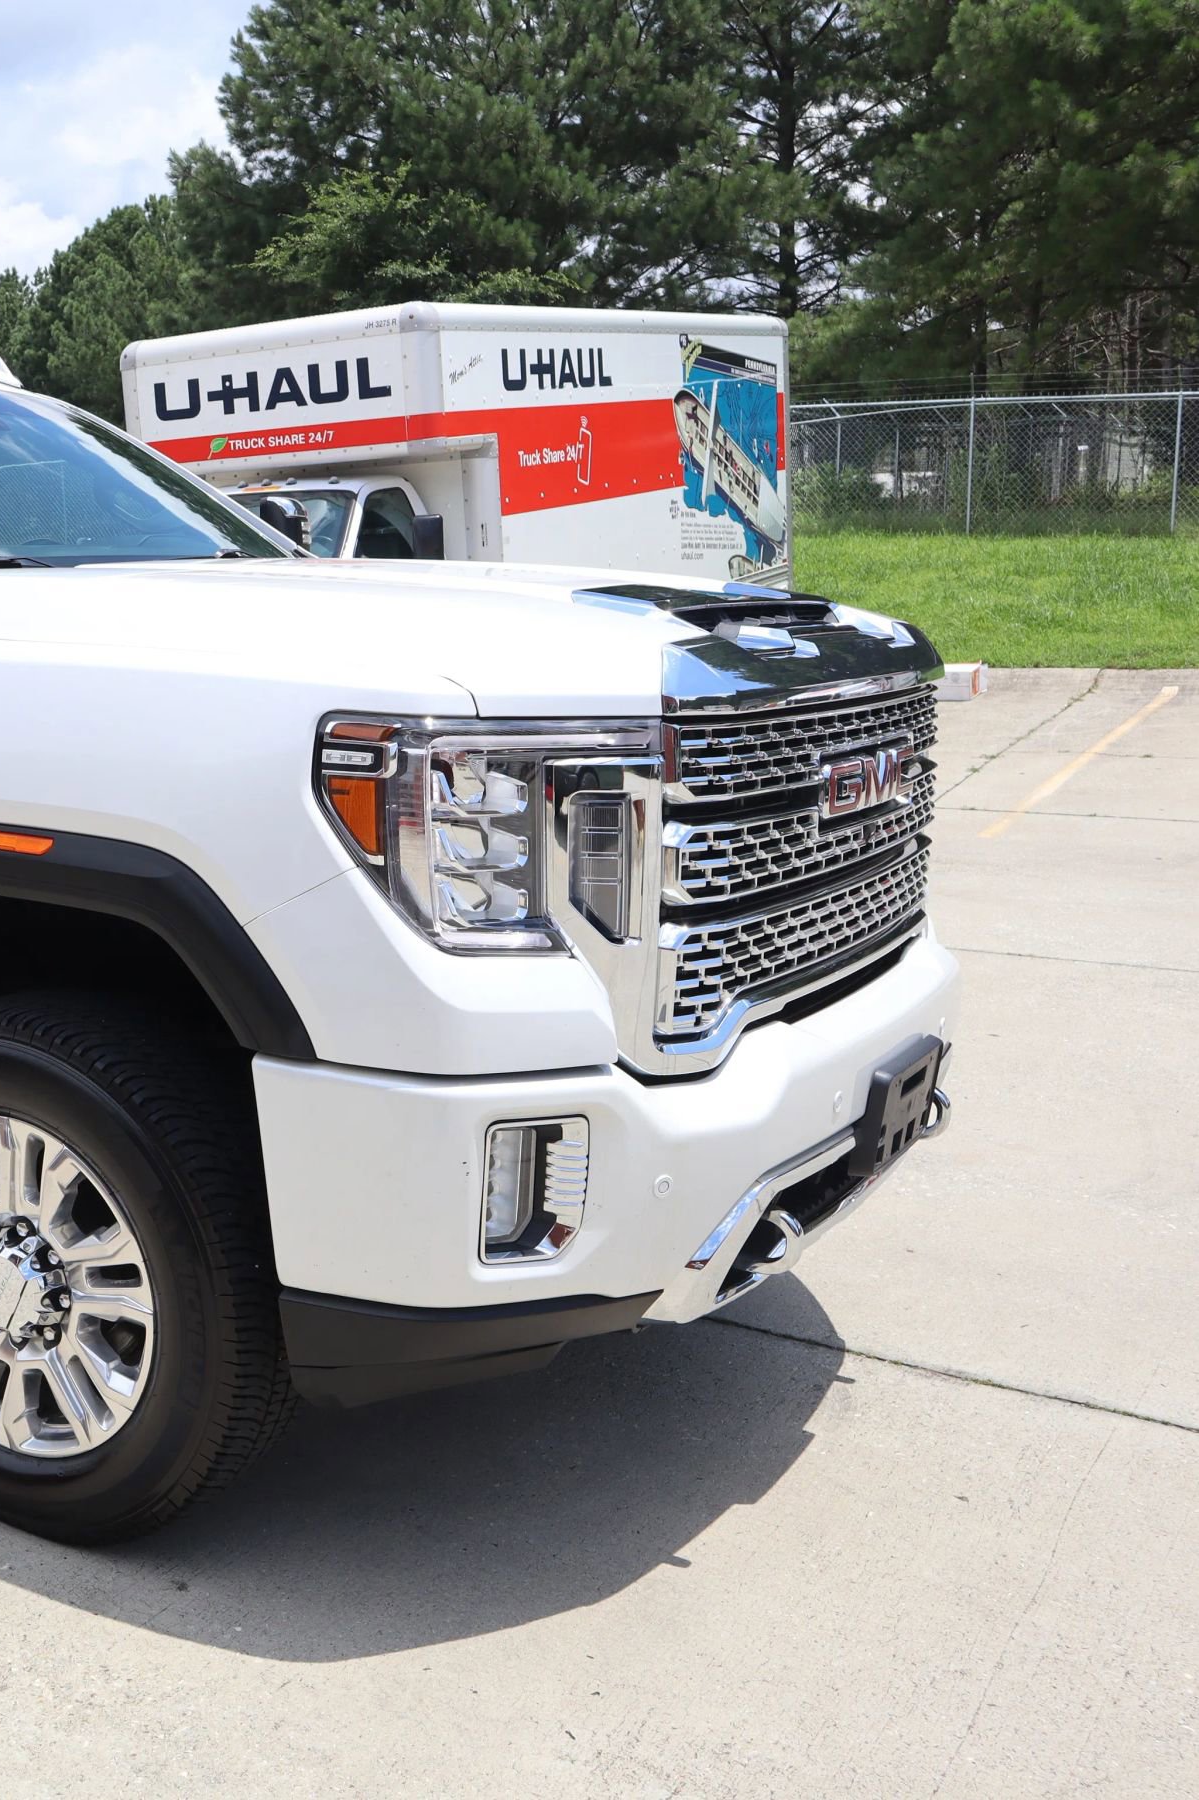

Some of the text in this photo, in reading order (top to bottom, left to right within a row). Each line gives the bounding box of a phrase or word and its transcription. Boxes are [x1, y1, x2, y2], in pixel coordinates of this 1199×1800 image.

[228, 430, 335, 451] TRUCK SHARE 24/7
[518, 441, 585, 467] Truck Share 24/7
[823, 747, 915, 818] GMC
